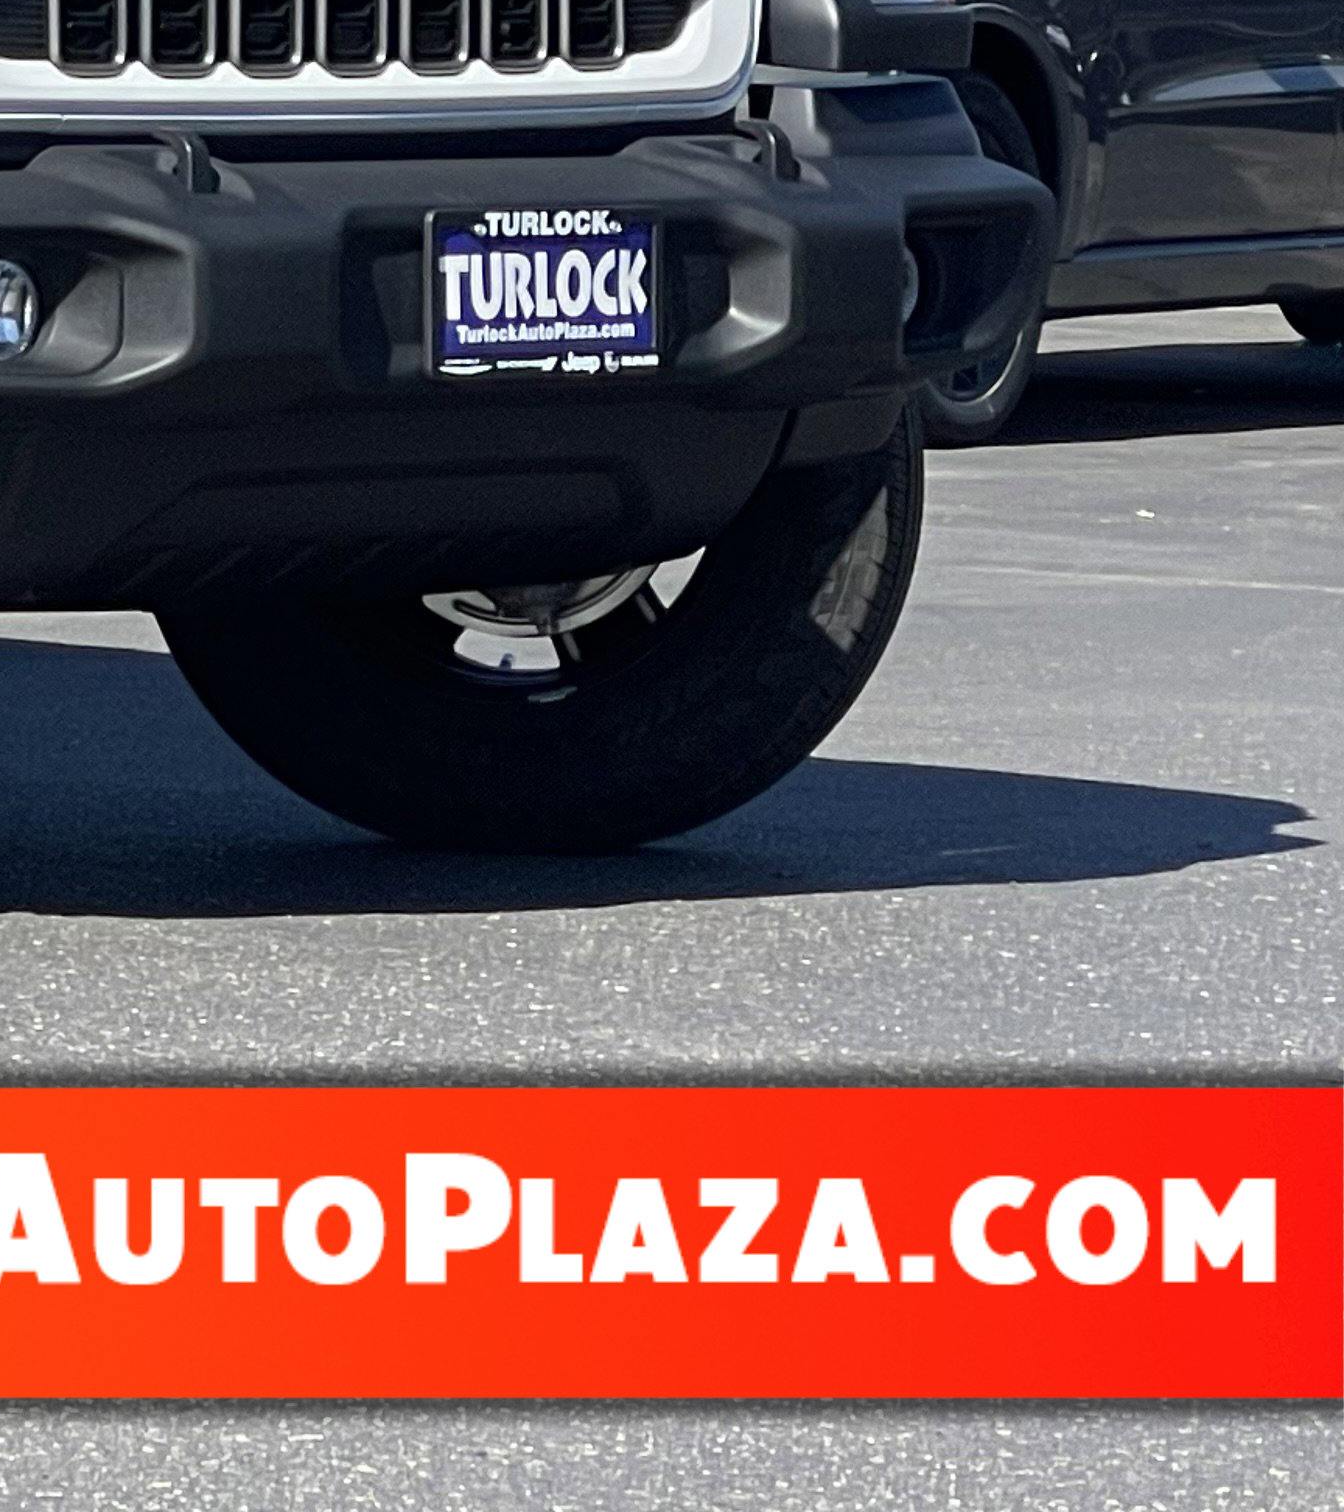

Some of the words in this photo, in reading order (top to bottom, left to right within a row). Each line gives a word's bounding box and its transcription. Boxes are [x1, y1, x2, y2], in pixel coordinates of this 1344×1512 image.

[482, 210, 612, 237] TURLOCK
[439, 248, 648, 321] TURLOCK
[455, 321, 635, 345] TurlockAutoPlaza.com
